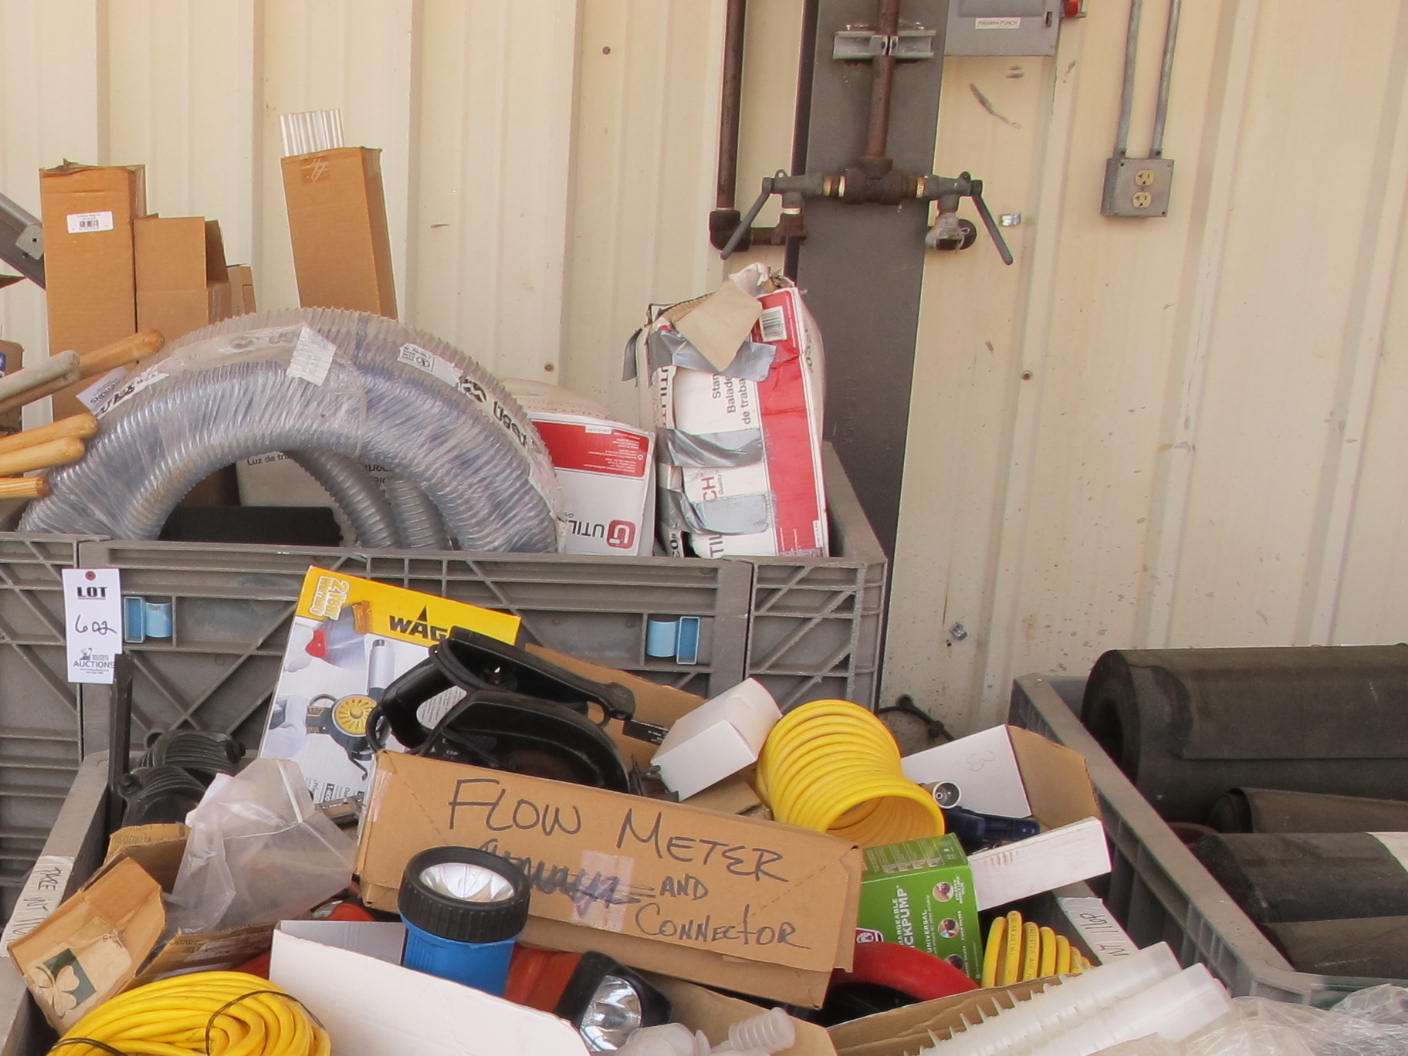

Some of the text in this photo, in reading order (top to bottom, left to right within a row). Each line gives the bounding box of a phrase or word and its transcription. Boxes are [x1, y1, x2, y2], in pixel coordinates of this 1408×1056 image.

[247, 457, 263, 466] Luz
[77, 586, 107, 598] LOT
[75, 614, 118, 635] 602
[448, 777, 583, 836] FLOW
[616, 807, 790, 883] METER
[659, 876, 709, 900] AND
